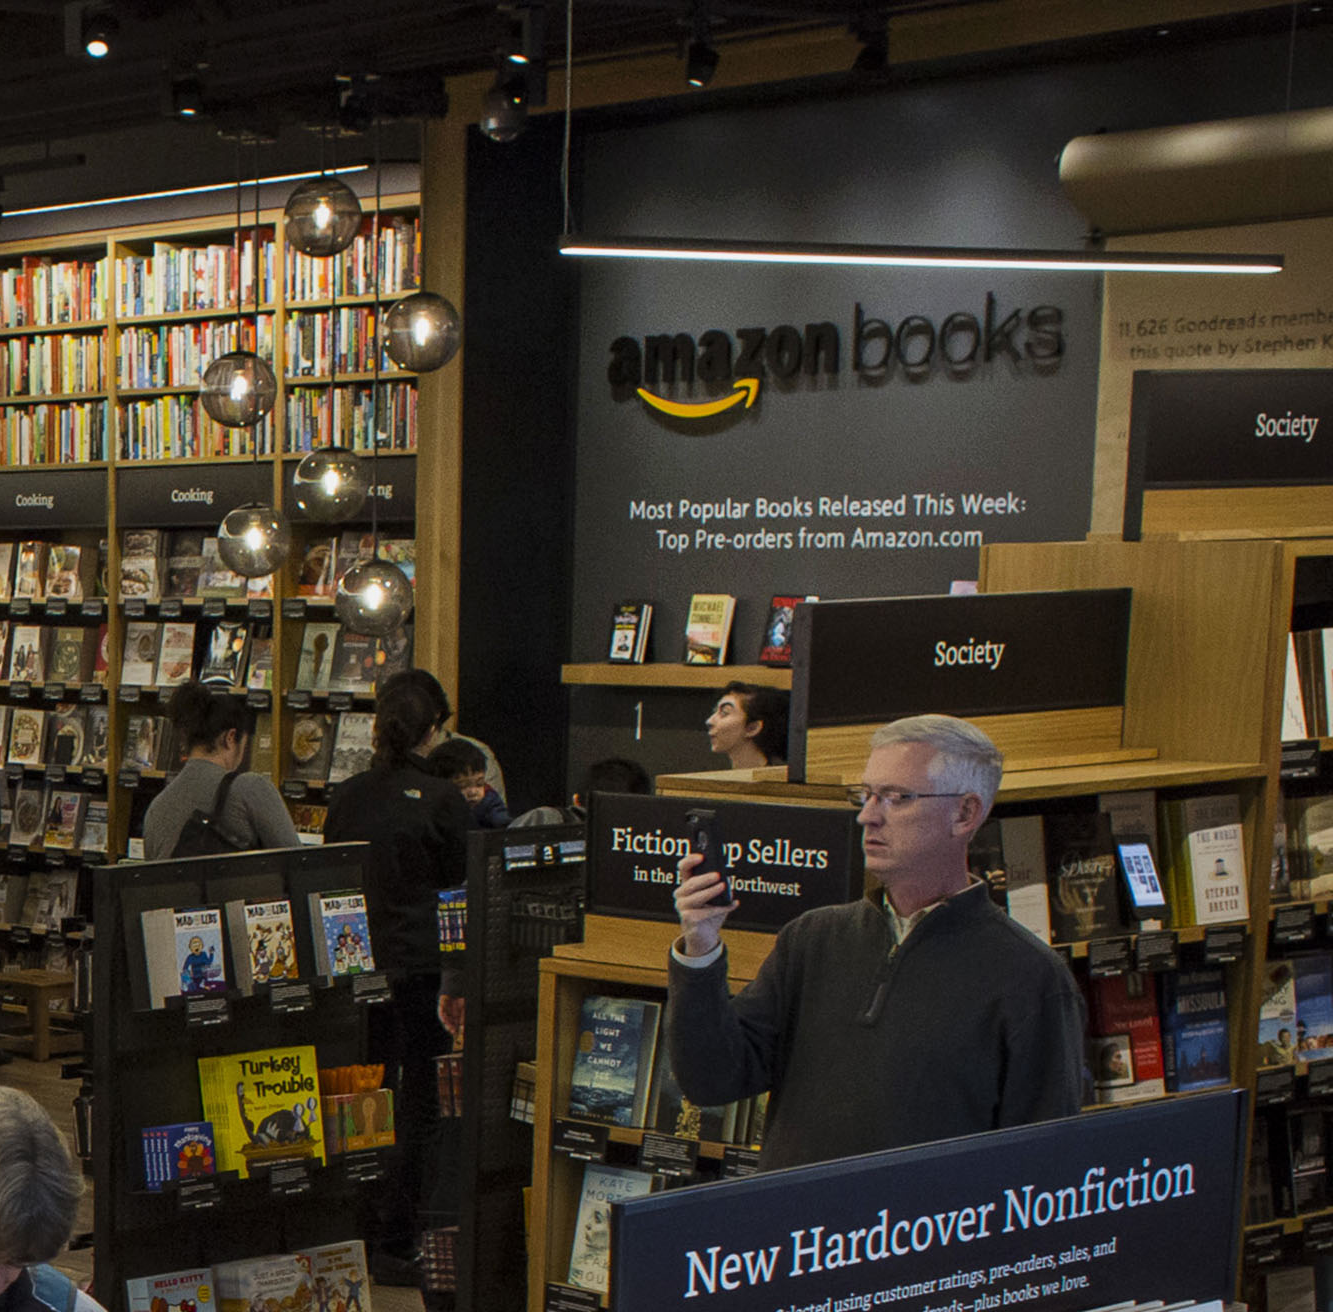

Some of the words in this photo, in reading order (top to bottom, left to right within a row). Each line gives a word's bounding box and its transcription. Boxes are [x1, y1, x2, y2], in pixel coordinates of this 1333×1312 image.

[608, 322, 840, 386] amazon
[854, 292, 1065, 376] books
[1255, 411, 1318, 442] Society
[15, 493, 54, 509] Cooking
[171, 488, 213, 505] Cooking
[630, 501, 673, 520] Most
[679, 498, 748, 525] Popular
[756, 498, 812, 517] Books
[819, 495, 906, 517] Released
[914, 494, 954, 515] This
[961, 492, 1026, 514] Week:
[657, 531, 689, 552] Top
[695, 529, 793, 549] Pre-orders
[798, 528, 844, 548] from
[851, 527, 983, 548] Amazon.com
[934, 638, 1005, 669] Society
[612, 827, 691, 858] Fiction
[748, 838, 829, 870] Sellers
[634, 865, 648, 882] in
[650, 867, 674, 884] the
[239, 1056, 301, 1077] Turkey
[253, 1075, 315, 1098] Trouble
[684, 1245, 781, 1299] New
[790, 1201, 996, 1278] Hardcover
[1004, 1157, 1196, 1235] Nonfiction
[874, 1278, 937, 1306] customer
[938, 1267, 987, 1294] ratings,
[989, 1252, 1056, 1286] pre-orders,
[1058, 1245, 1091, 1270] sales,
[1093, 1236, 1117, 1258] and
[1003, 1282, 1040, 1309] books
[1042, 1282, 1060, 1298] we
[1061, 1273, 1091, 1293] love.
